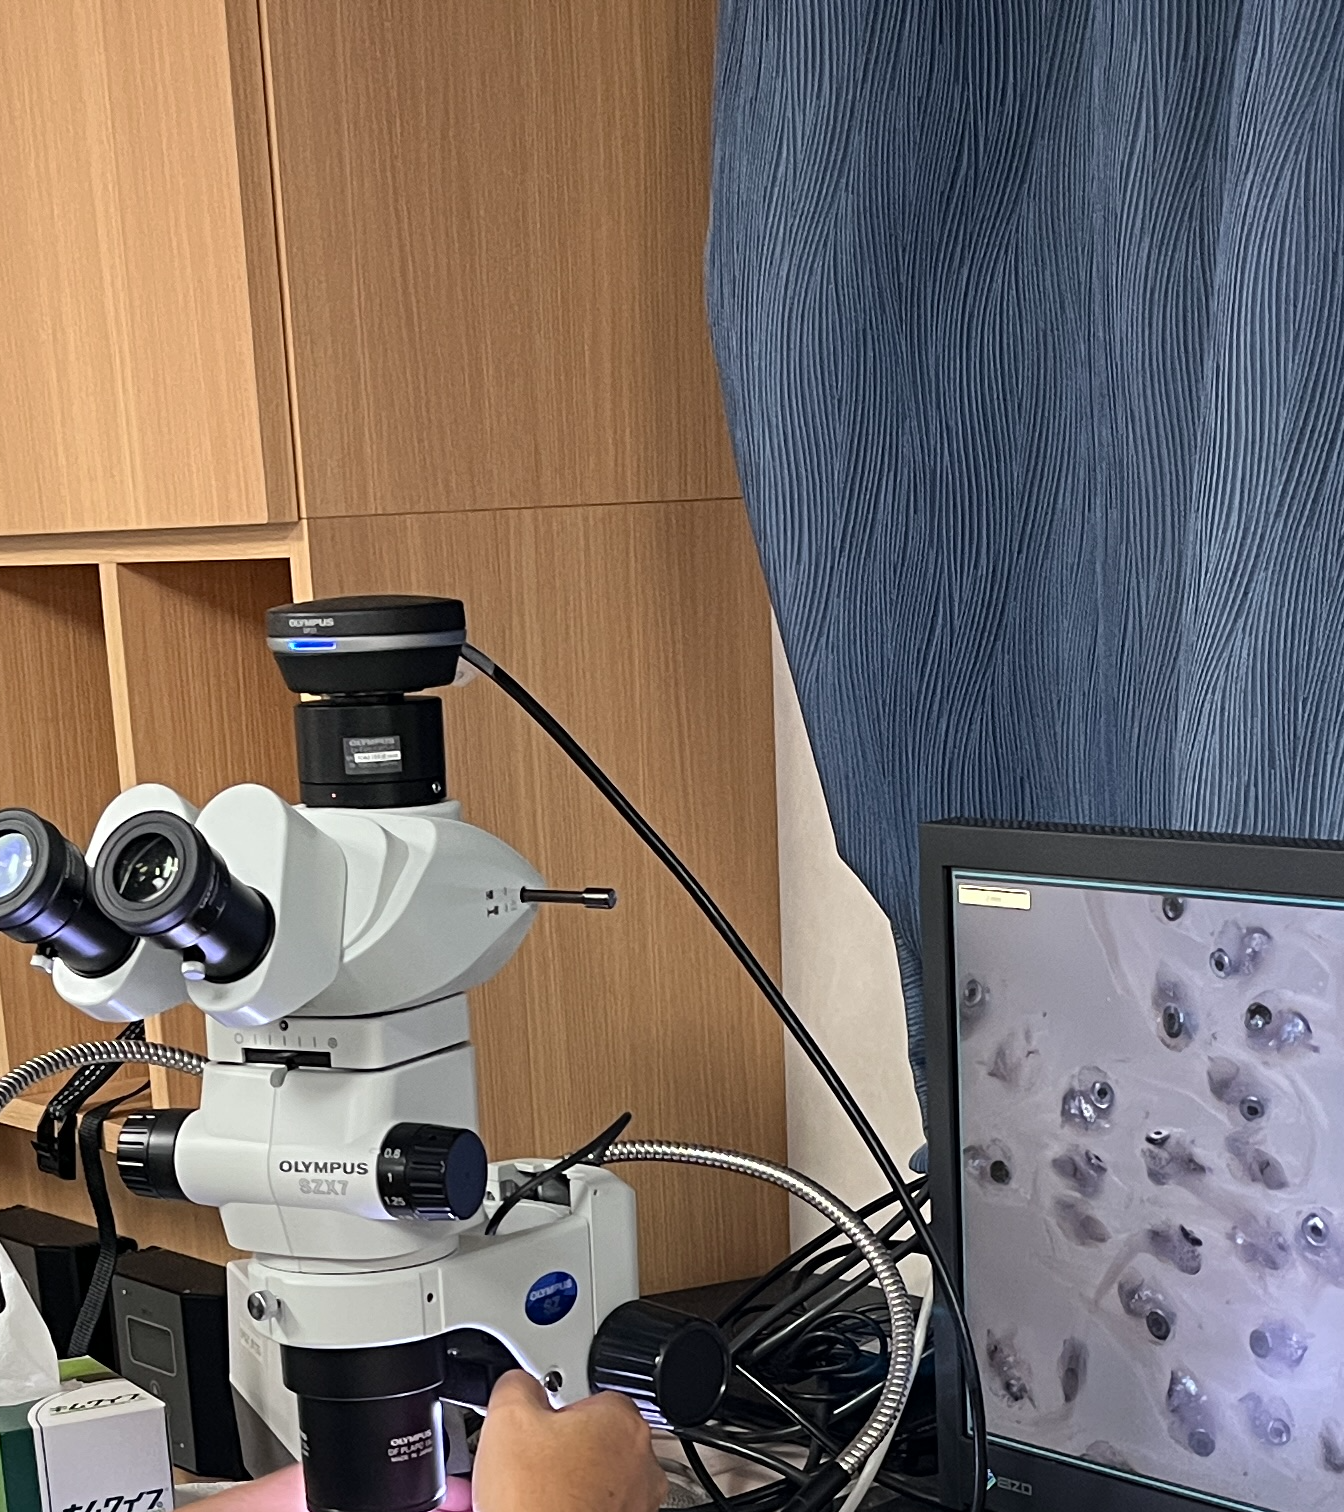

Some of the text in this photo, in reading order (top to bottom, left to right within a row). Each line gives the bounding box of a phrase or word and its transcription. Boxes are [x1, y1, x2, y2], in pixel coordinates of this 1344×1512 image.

[289, 617, 334, 628] OLYMPUS
[279, 1160, 369, 1175] OLYMPUS
[298, 1178, 349, 1196] SZX7
